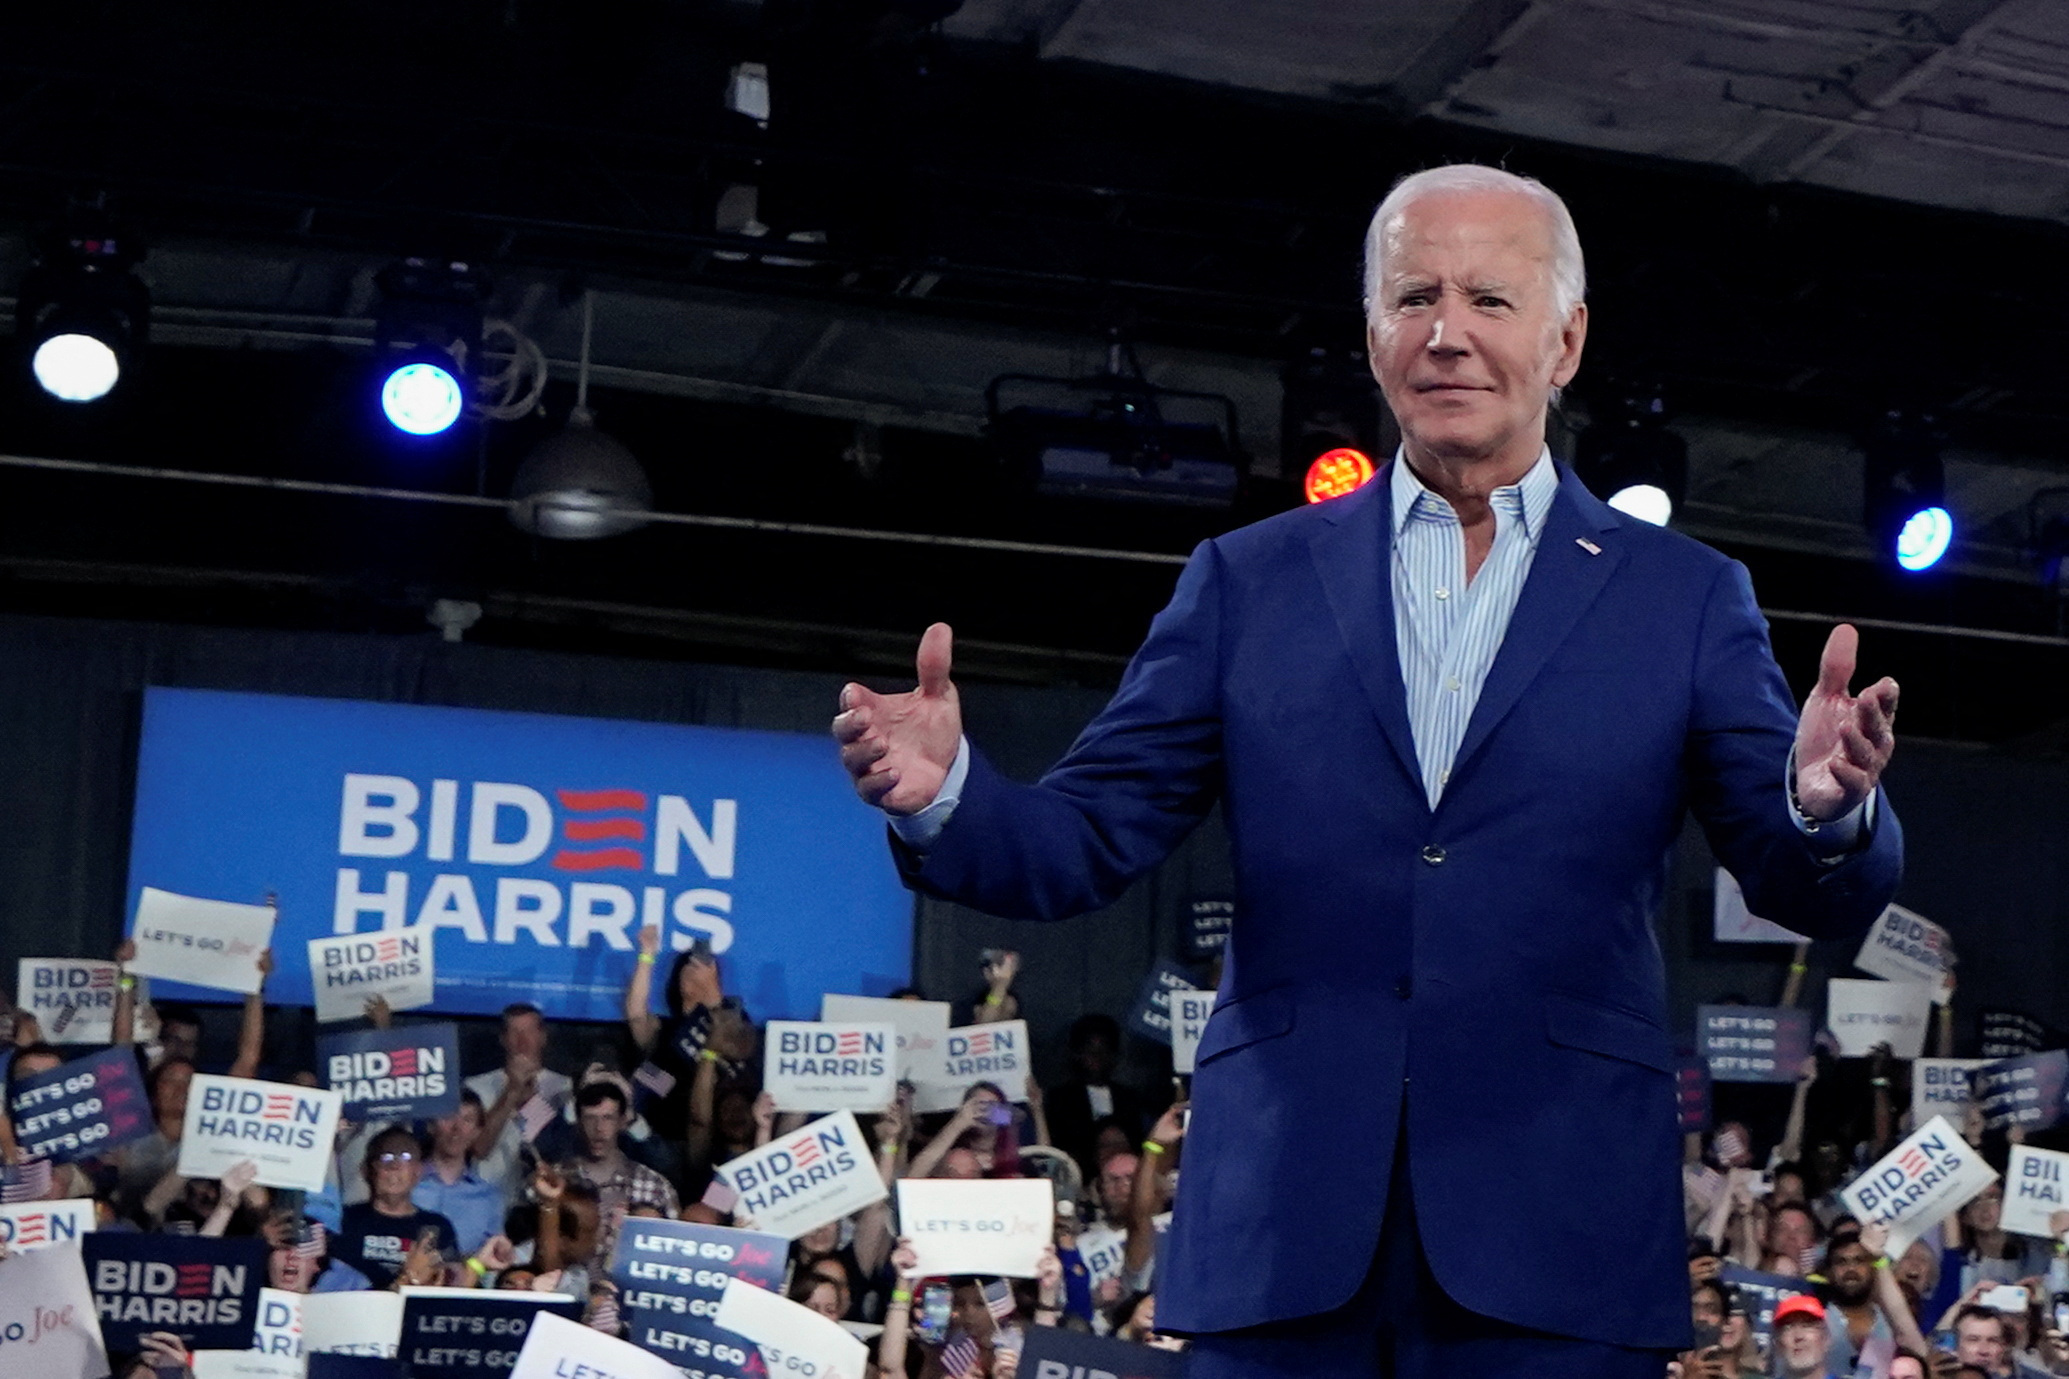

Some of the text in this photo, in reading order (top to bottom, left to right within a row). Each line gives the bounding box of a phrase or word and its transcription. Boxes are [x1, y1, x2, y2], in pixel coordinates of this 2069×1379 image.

[339, 773, 737, 878] BIDEN
[333, 868, 734, 954] HARRIS
[324, 935, 419, 967] BIDEN
[33, 968, 114, 988] BIDE
[326, 958, 421, 987] HARRIS
[33, 990, 113, 1008] HARR
[780, 1032, 884, 1055] BIDEN
[949, 1030, 1013, 1057] DEN
[329, 1047, 445, 1081] BIDEN
[779, 1058, 884, 1076] HARRIS
[945, 1053, 1016, 1076] ARRIS
[12, 1073, 96, 1111] LET'S GO
[329, 1073, 447, 1101] HARRIS
[15, 1098, 103, 1136] LET'S GO
[203, 1087, 322, 1124] BIDEN
[32, 1133, 79, 1157] ET'S
[79, 1123, 110, 1143] GO
[197, 1116, 315, 1149] HARRIS
[734, 1125, 845, 1192] BIDEN
[1857, 1133, 1947, 1211] BIDEN
[745, 1151, 856, 1214] HARRIS
[1876, 1154, 1962, 1225] HARRIS
[0, 1212, 76, 1245] DEN
[915, 1219, 971, 1232] LET'S
[976, 1220, 1004, 1232] GO
[634, 1234, 698, 1257] LET'S
[699, 1242, 735, 1262] GO
[95, 1259, 247, 1297] BIDEN
[628, 1260, 693, 1285] LET'S
[694, 1270, 729, 1290] GO
[95, 1294, 242, 1325] HARRIS
[623, 1290, 721, 1318] LET'S GO
[28, 1304, 74, 1344] Joe
[417, 1315, 527, 1336] LET'S GO
[413, 1348, 481, 1366] LET'S
[484, 1350, 519, 1368] GO
[646, 1328, 711, 1356] LET'S
[711, 1344, 747, 1366] GO
[785, 1356, 816, 1377] GO
